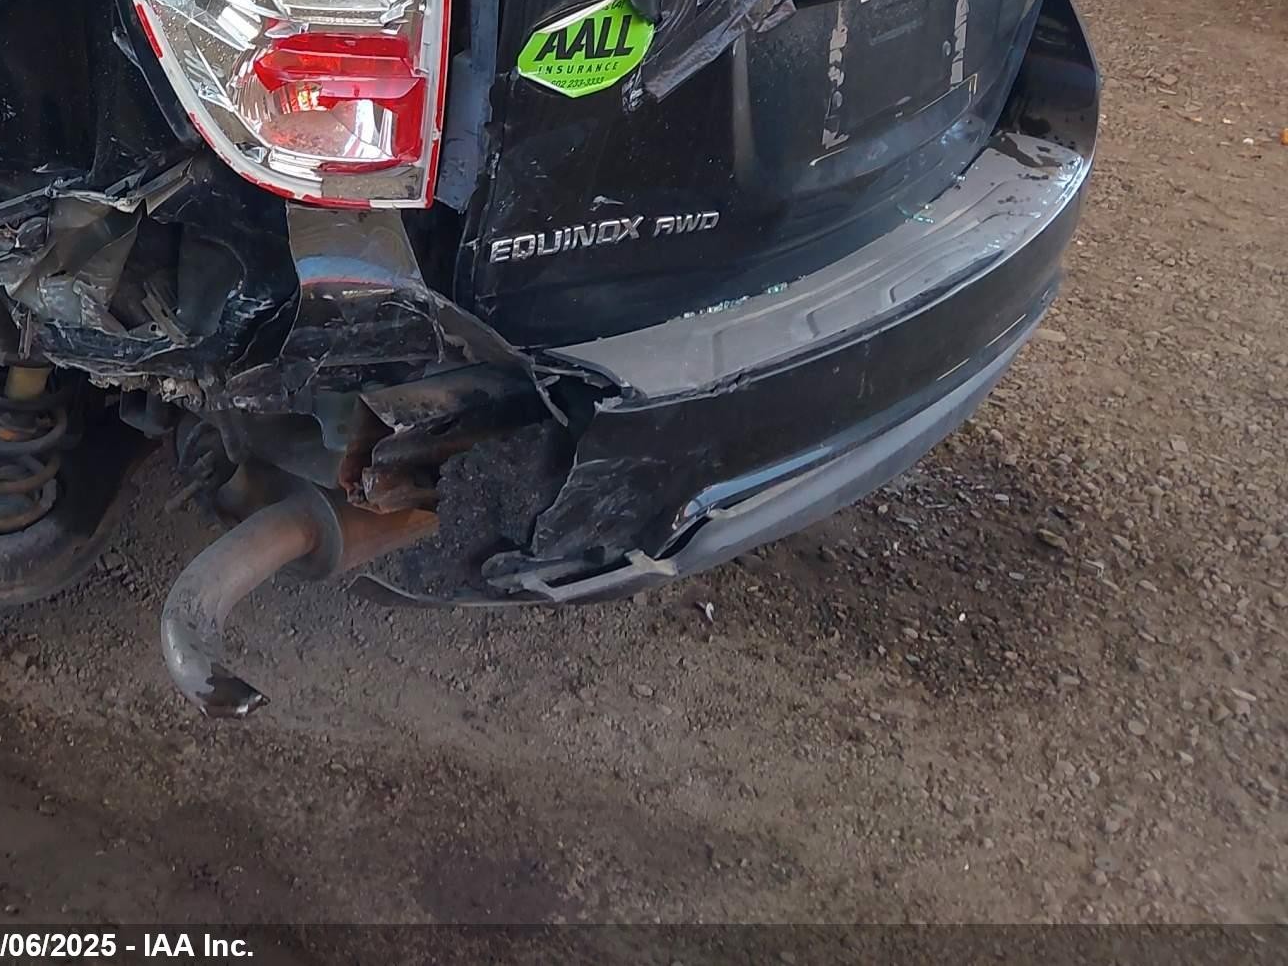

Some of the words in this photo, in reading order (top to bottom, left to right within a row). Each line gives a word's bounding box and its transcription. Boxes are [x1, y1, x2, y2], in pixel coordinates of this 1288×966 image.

[534, 14, 634, 62] AALL
[538, 61, 620, 75] INSURANCE
[489, 216, 644, 263] EQUINOX
[652, 211, 720, 236] AWD
